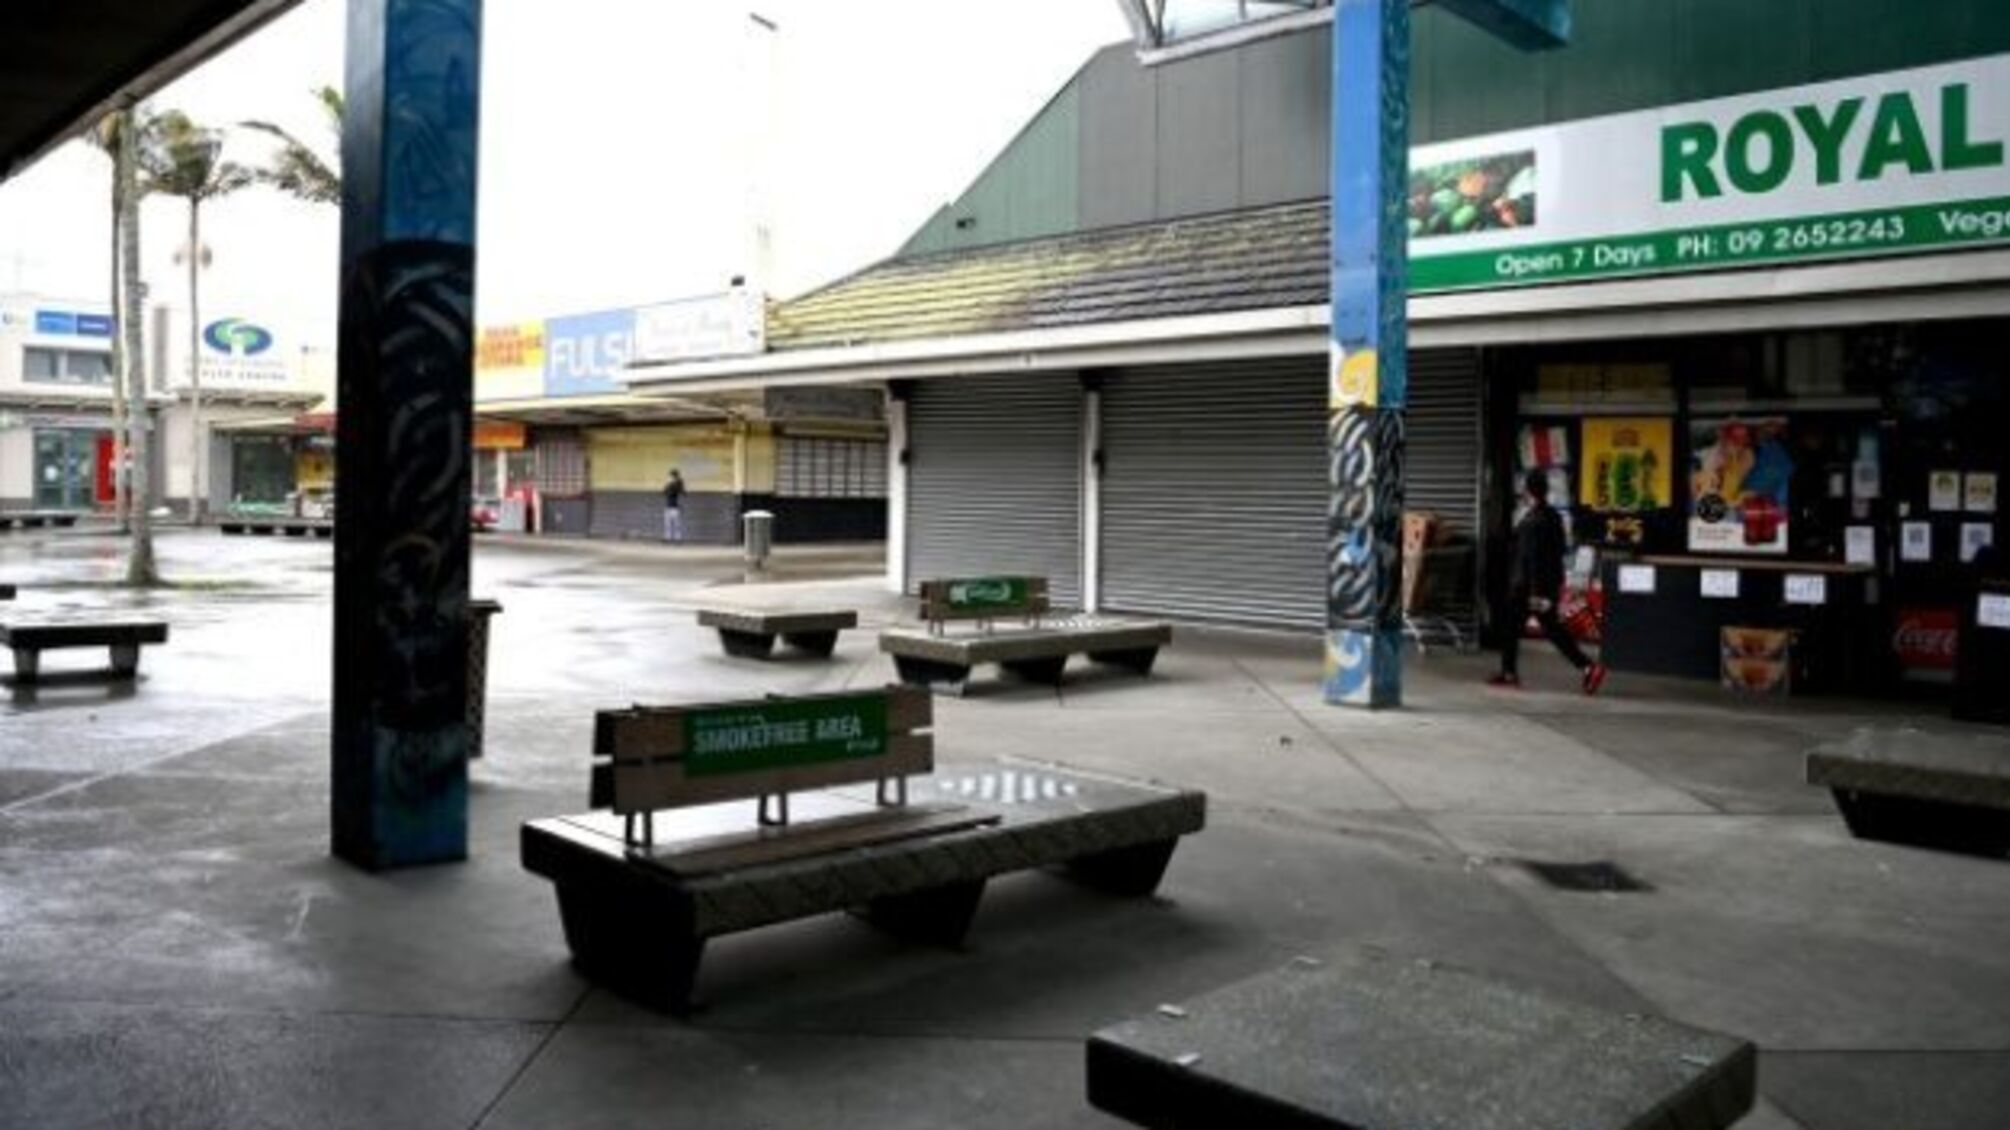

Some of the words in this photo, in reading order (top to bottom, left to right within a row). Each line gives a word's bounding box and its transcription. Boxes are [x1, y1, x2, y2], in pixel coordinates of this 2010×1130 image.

[1660, 83, 2002, 203] ROYAL
[1677, 233, 1718, 257] PH:
[1728, 229, 1763, 254] 09
[1773, 215, 1905, 250] 2652243
[1495, 252, 1564, 276] Open
[1572, 248, 1584, 267] 7
[1594, 242, 1656, 268] Days
[693, 721, 810, 756] SMOKEFREE
[815, 714, 862, 740] AREA
